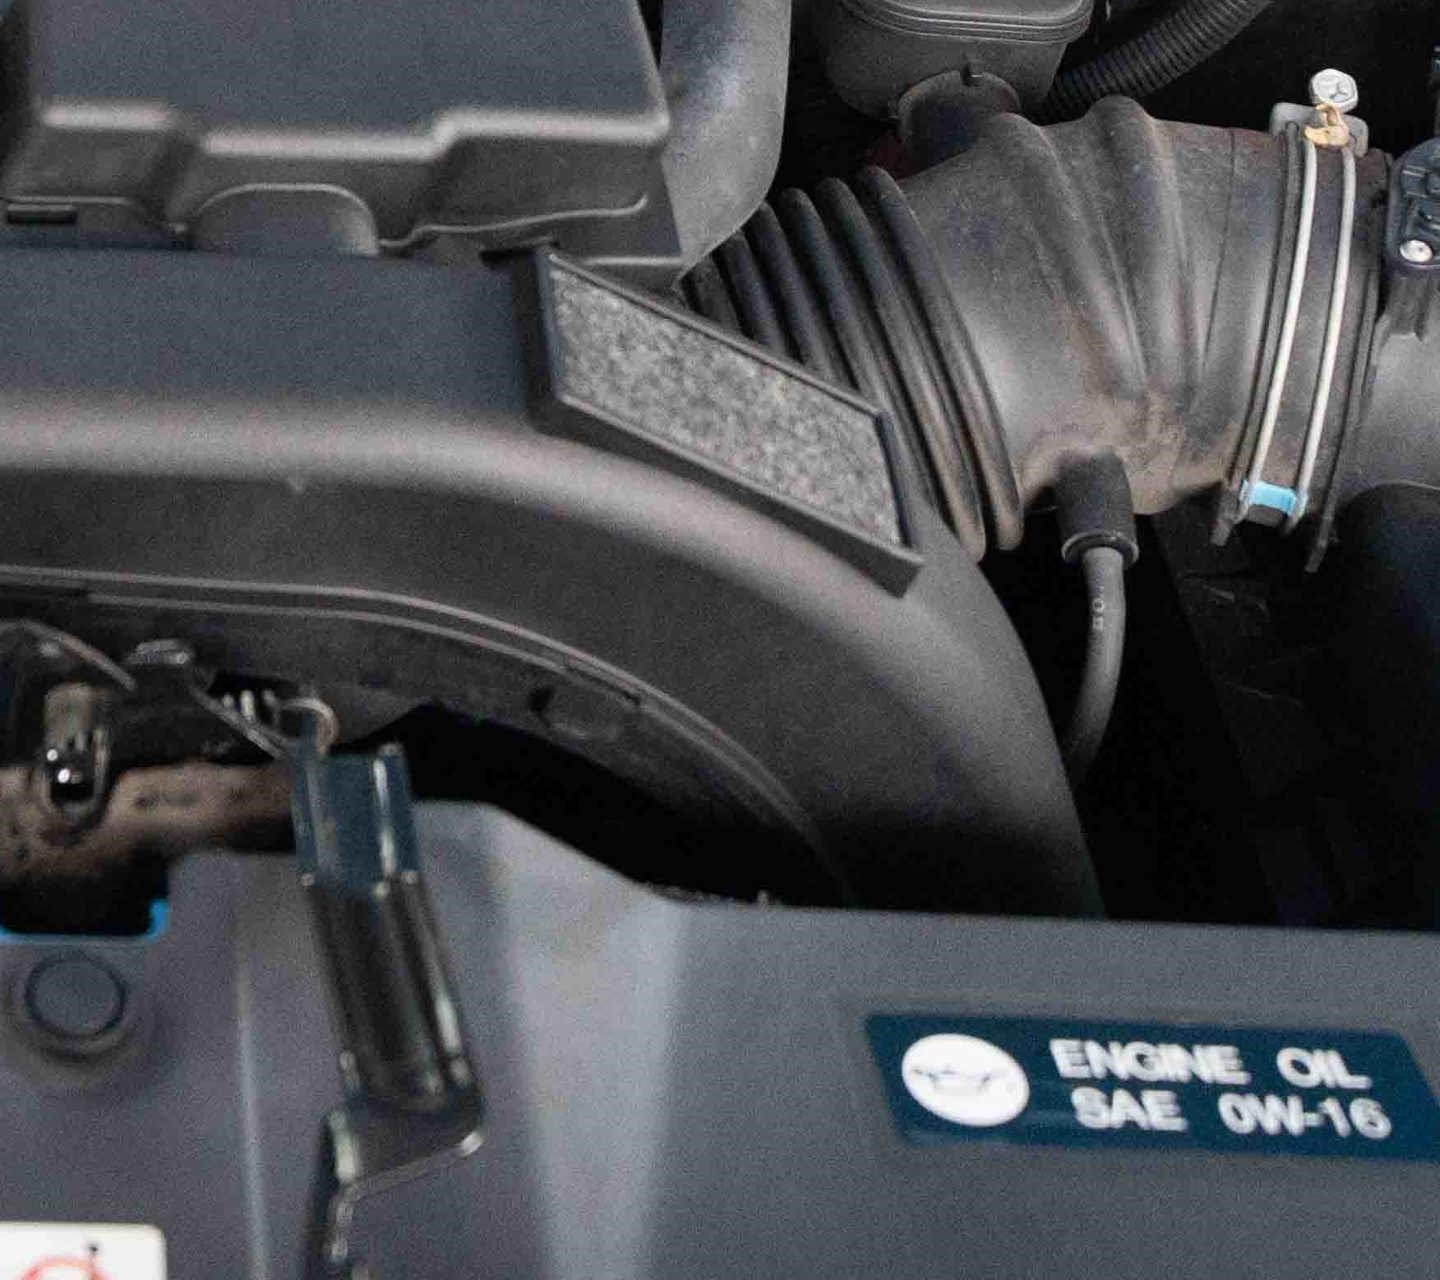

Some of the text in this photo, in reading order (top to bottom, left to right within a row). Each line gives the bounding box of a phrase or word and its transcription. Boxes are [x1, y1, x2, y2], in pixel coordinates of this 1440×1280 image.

[1049, 1038, 1370, 1089] ENGINE OIL
[1070, 1088, 1392, 1140] SAE 0W-16
